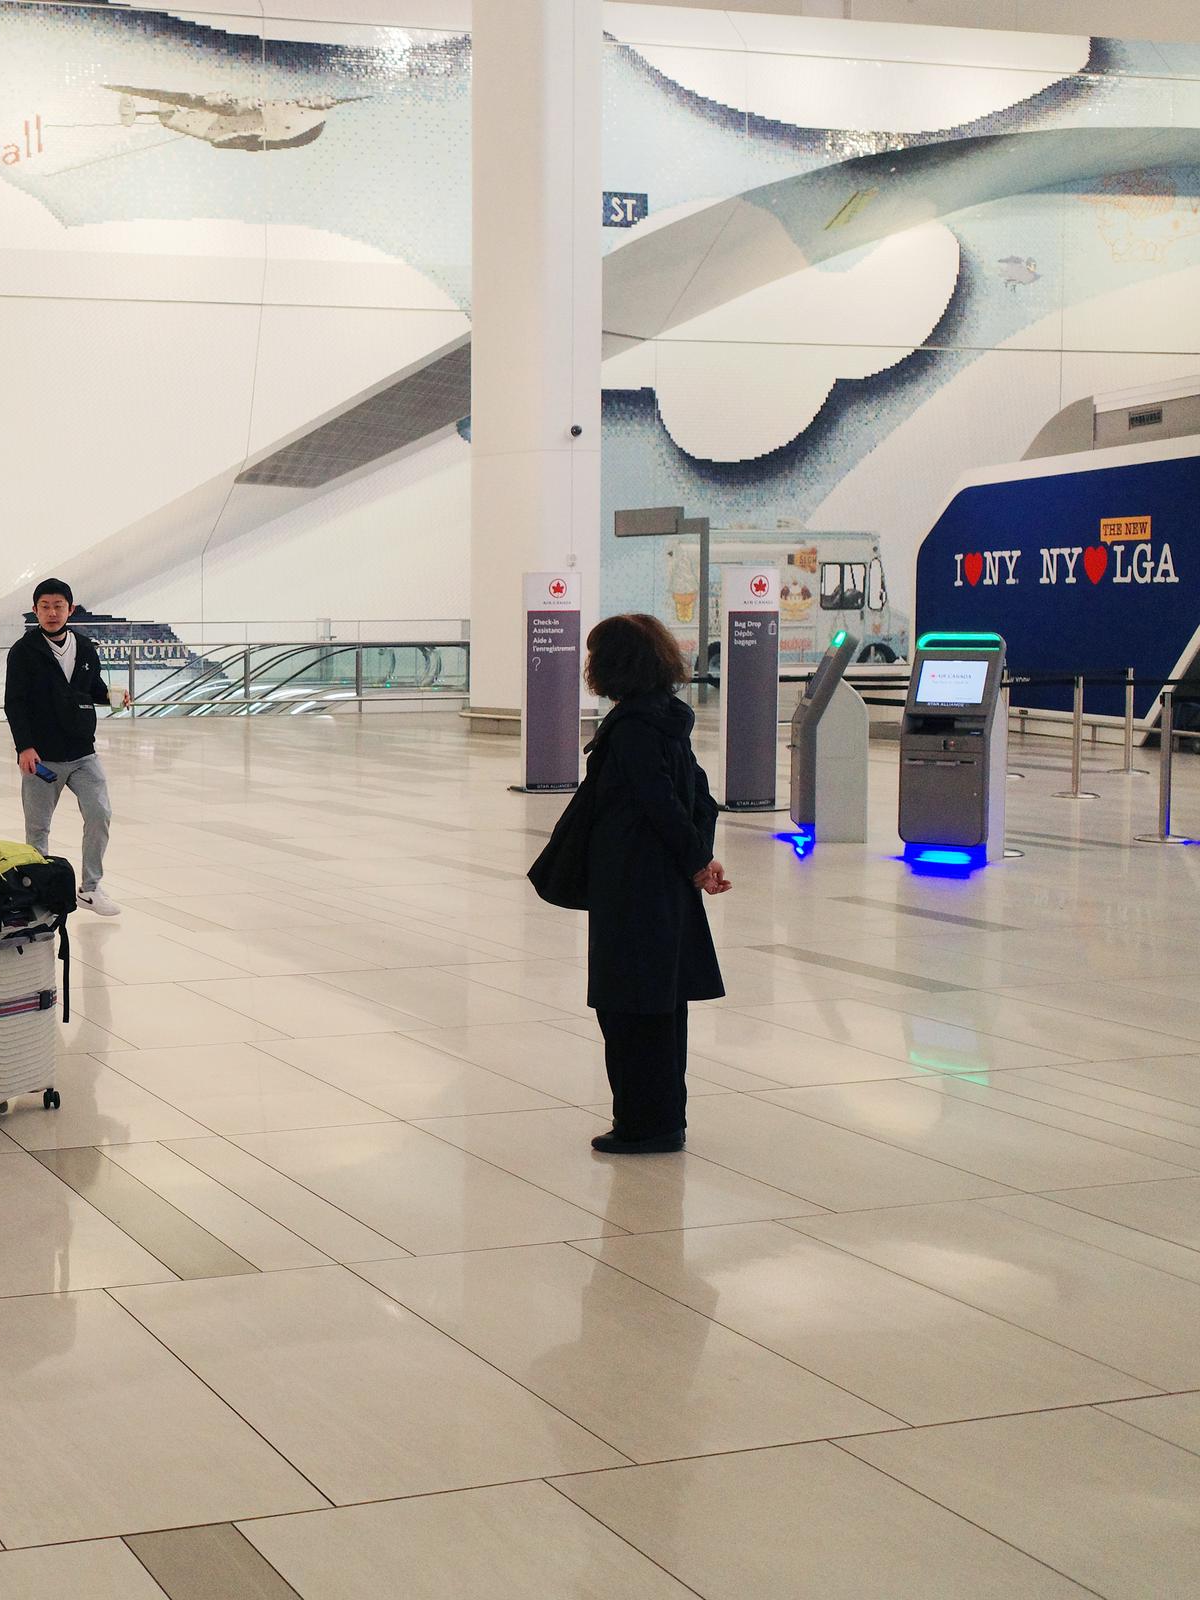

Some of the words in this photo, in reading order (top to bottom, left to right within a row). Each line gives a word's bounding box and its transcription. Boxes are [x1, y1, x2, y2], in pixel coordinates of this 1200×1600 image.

[1102, 523, 1123, 536] THE
[1125, 521, 1148, 536] NEW
[954, 553, 964, 587] I
[983, 550, 1022, 586] NY
[1039, 547, 1083, 585] NY
[1112, 543, 1179, 584] LGA
[747, 621, 762, 629] Drop
[532, 645, 576, 653] l'enregistrement
